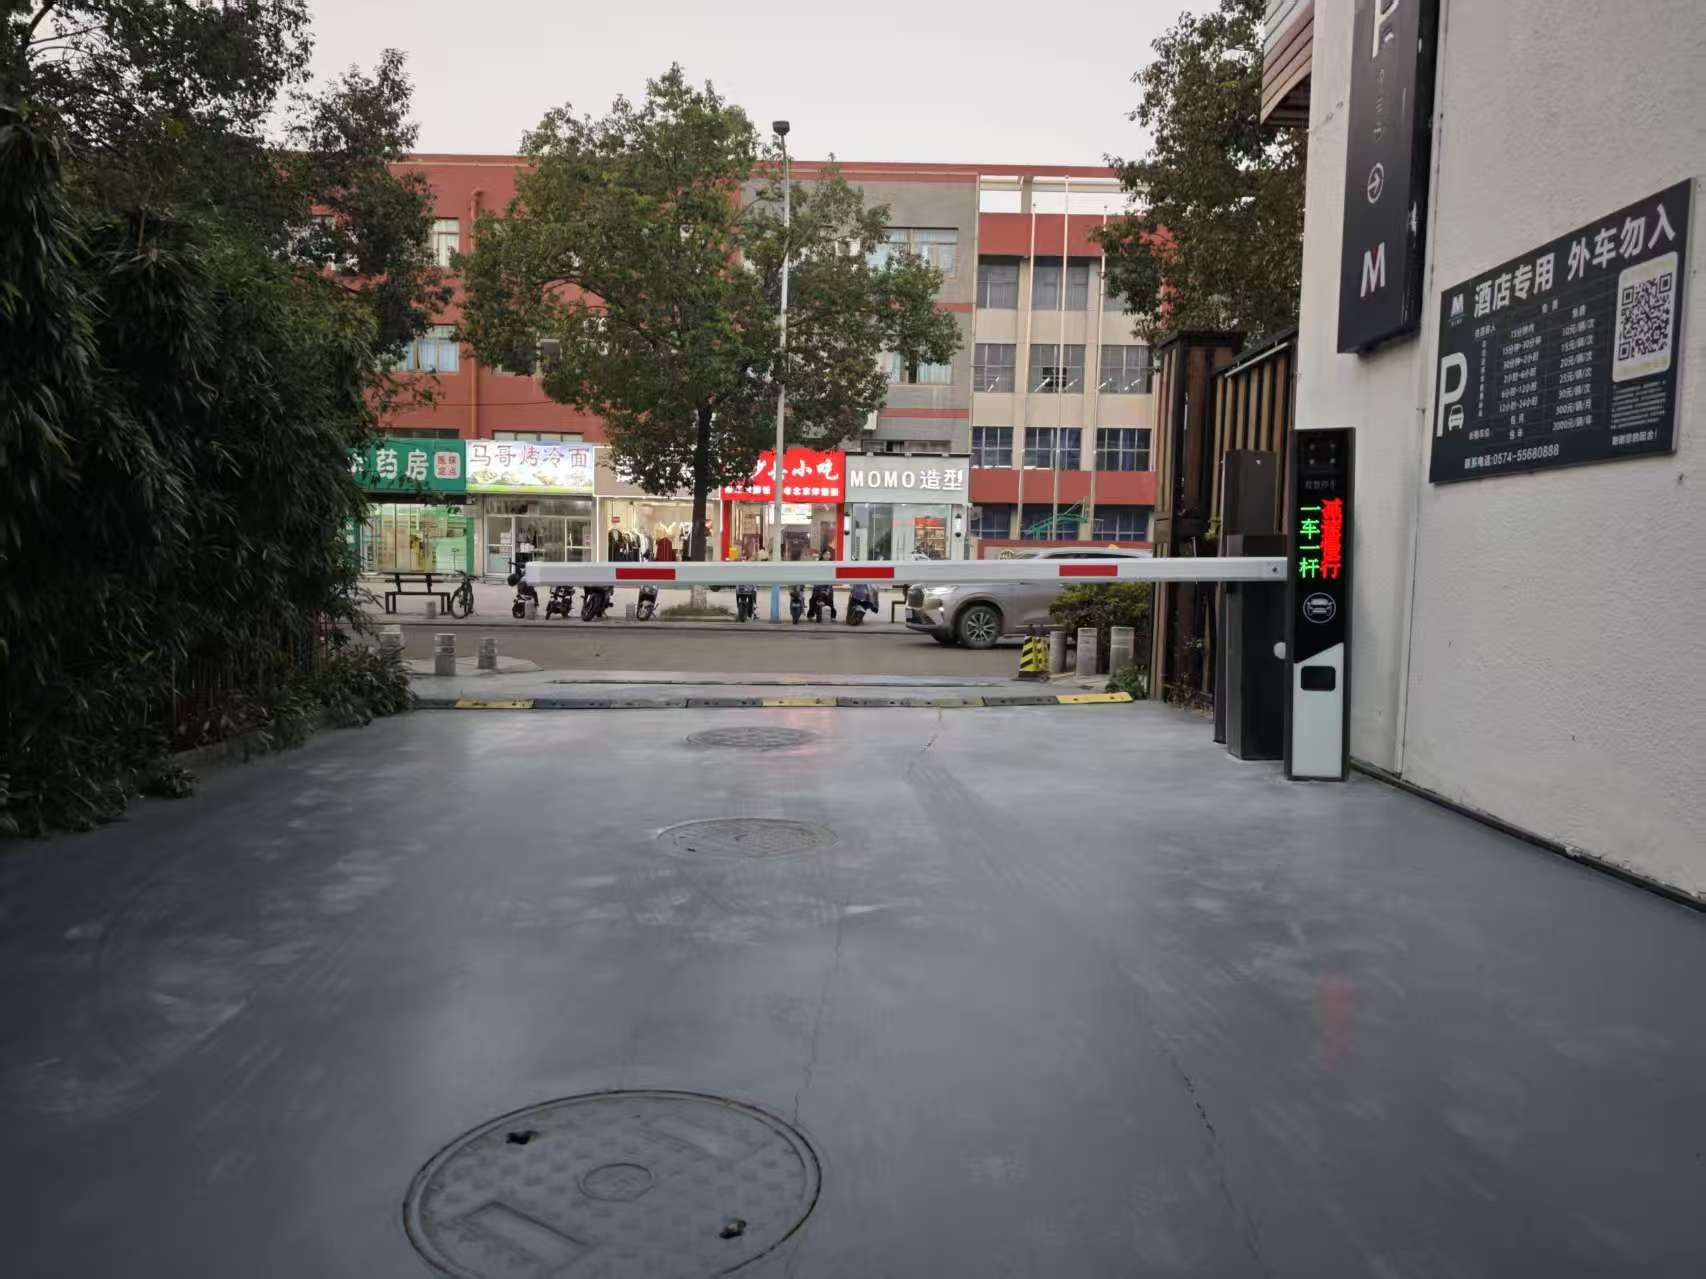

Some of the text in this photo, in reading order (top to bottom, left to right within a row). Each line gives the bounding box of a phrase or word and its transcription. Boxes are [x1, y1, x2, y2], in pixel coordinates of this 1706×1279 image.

[1359, 241, 1387, 299] M
[1473, 203, 1677, 319] 酒店专用 外车勿入
[1450, 293, 1464, 318] M
[1436, 352, 1467, 438] P
[471, 444, 590, 469] 马哥烤冷面
[1298, 505, 1322, 579] 一车一杆
